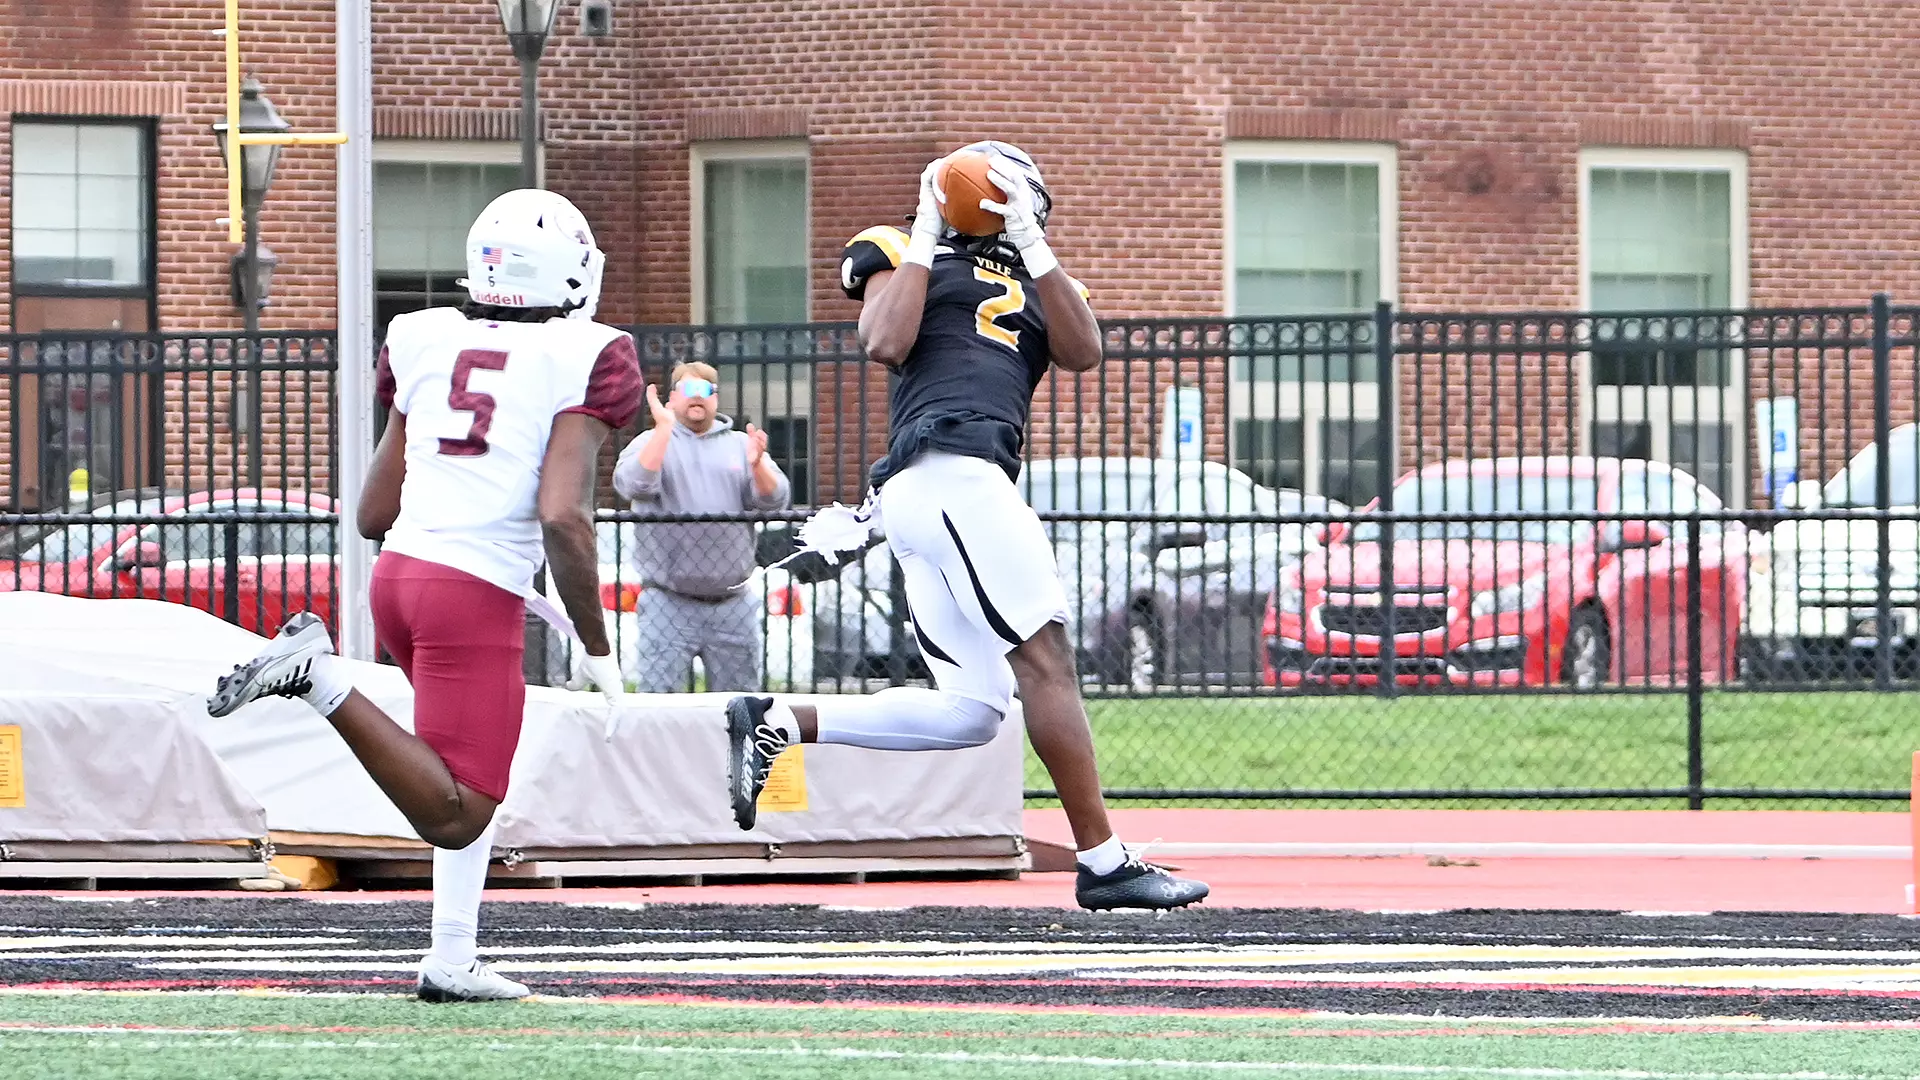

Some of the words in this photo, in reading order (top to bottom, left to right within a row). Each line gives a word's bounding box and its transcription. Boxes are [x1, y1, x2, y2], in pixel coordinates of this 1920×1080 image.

[973, 265, 1026, 352] 2
[975, 256, 1012, 277] VILLE
[437, 349, 510, 457] 5
